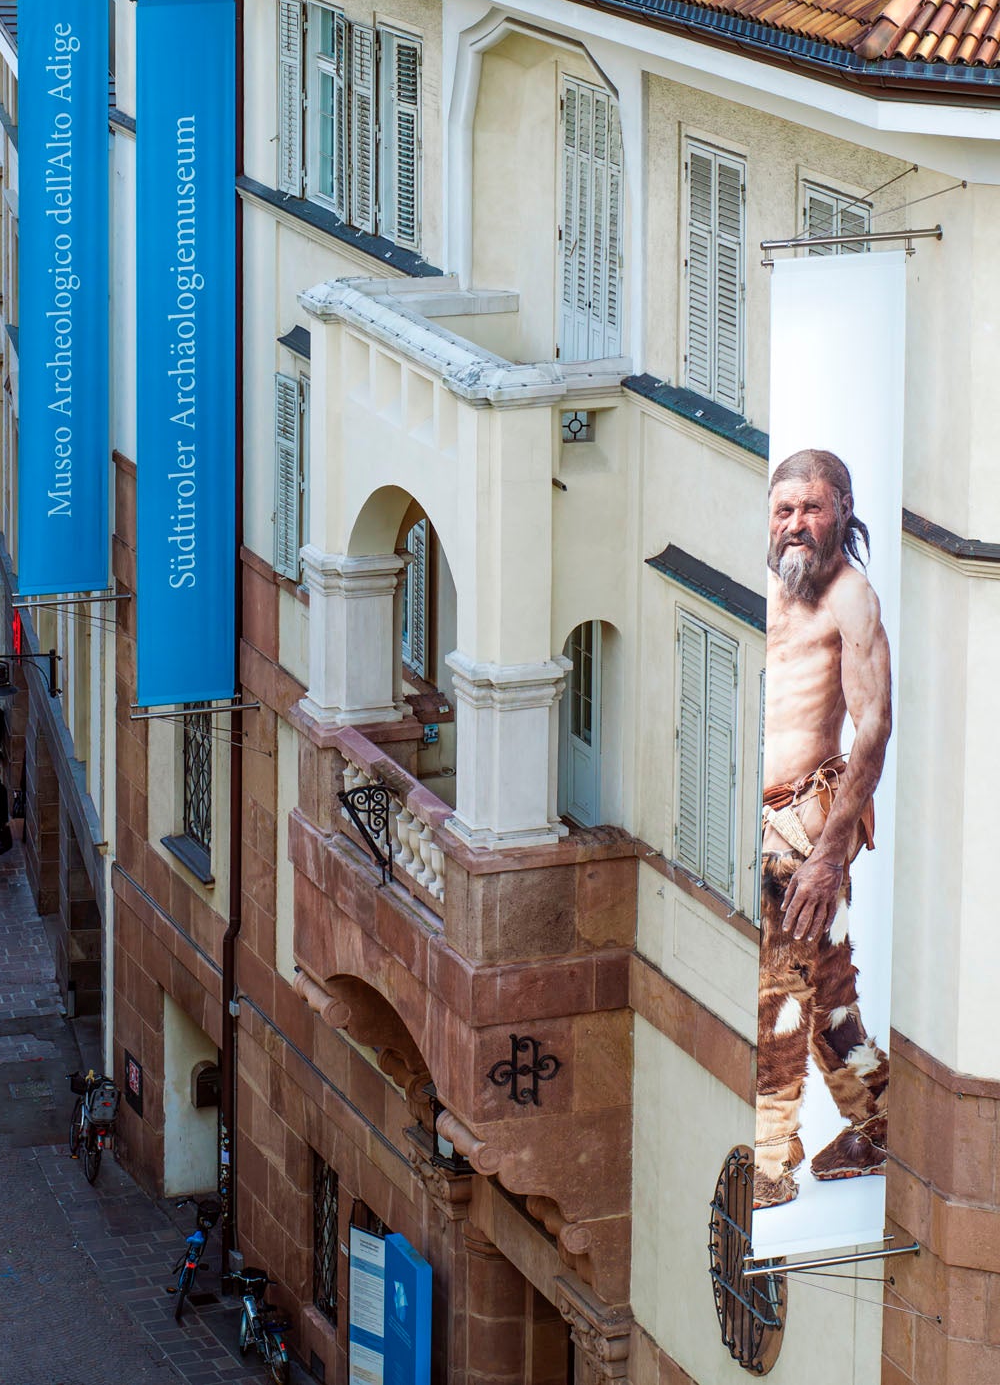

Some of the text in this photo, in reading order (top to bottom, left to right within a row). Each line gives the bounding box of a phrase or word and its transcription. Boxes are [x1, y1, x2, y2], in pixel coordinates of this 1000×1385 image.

[45, 23, 81, 516] Museo Archeologico dell'Alto Adige
[167, 115, 205, 588] Südtiroler Archäologiemuseum
